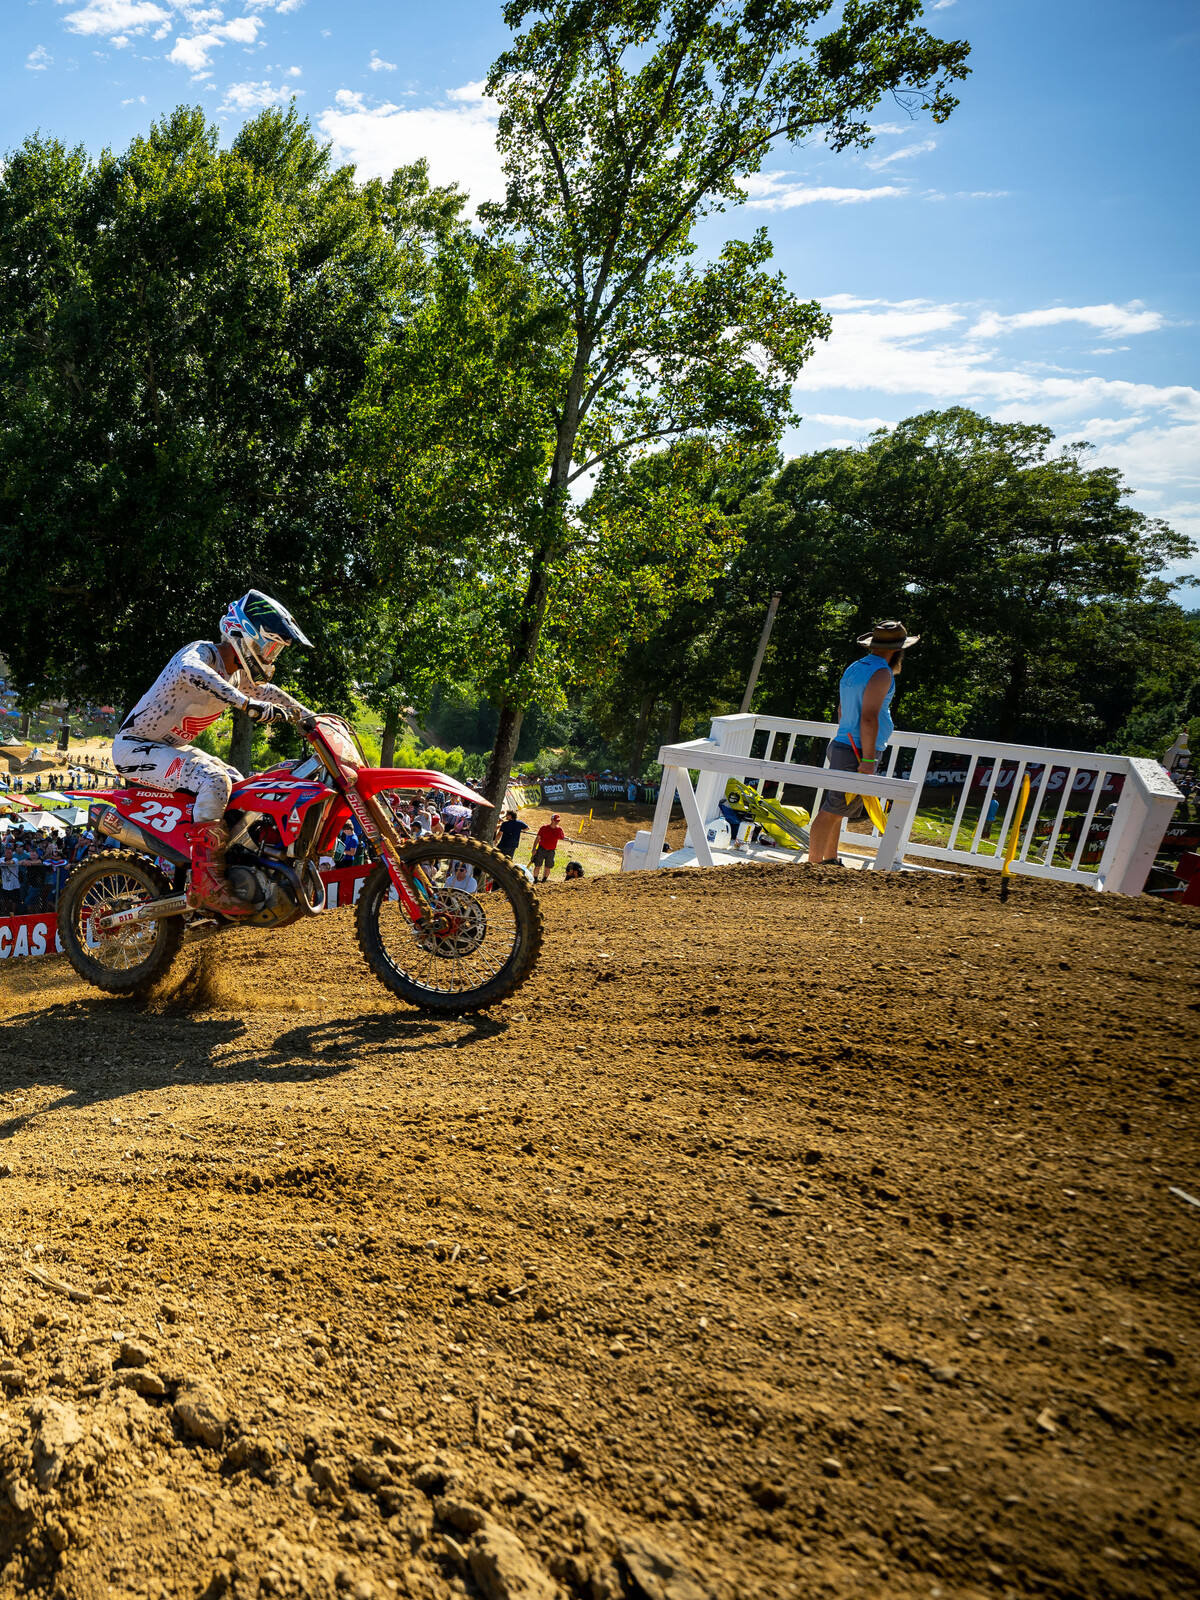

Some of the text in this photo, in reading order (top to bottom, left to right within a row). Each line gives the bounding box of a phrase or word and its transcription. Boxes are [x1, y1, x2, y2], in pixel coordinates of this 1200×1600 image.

[170, 726, 197, 741] HON
[901, 770, 968, 784] SACYC
[135, 790, 175, 799] HONDA
[544, 784, 564, 795] GEICO
[128, 800, 183, 833] 23
[346, 793, 376, 834] SHOWA
[118, 913, 134, 923] DID
